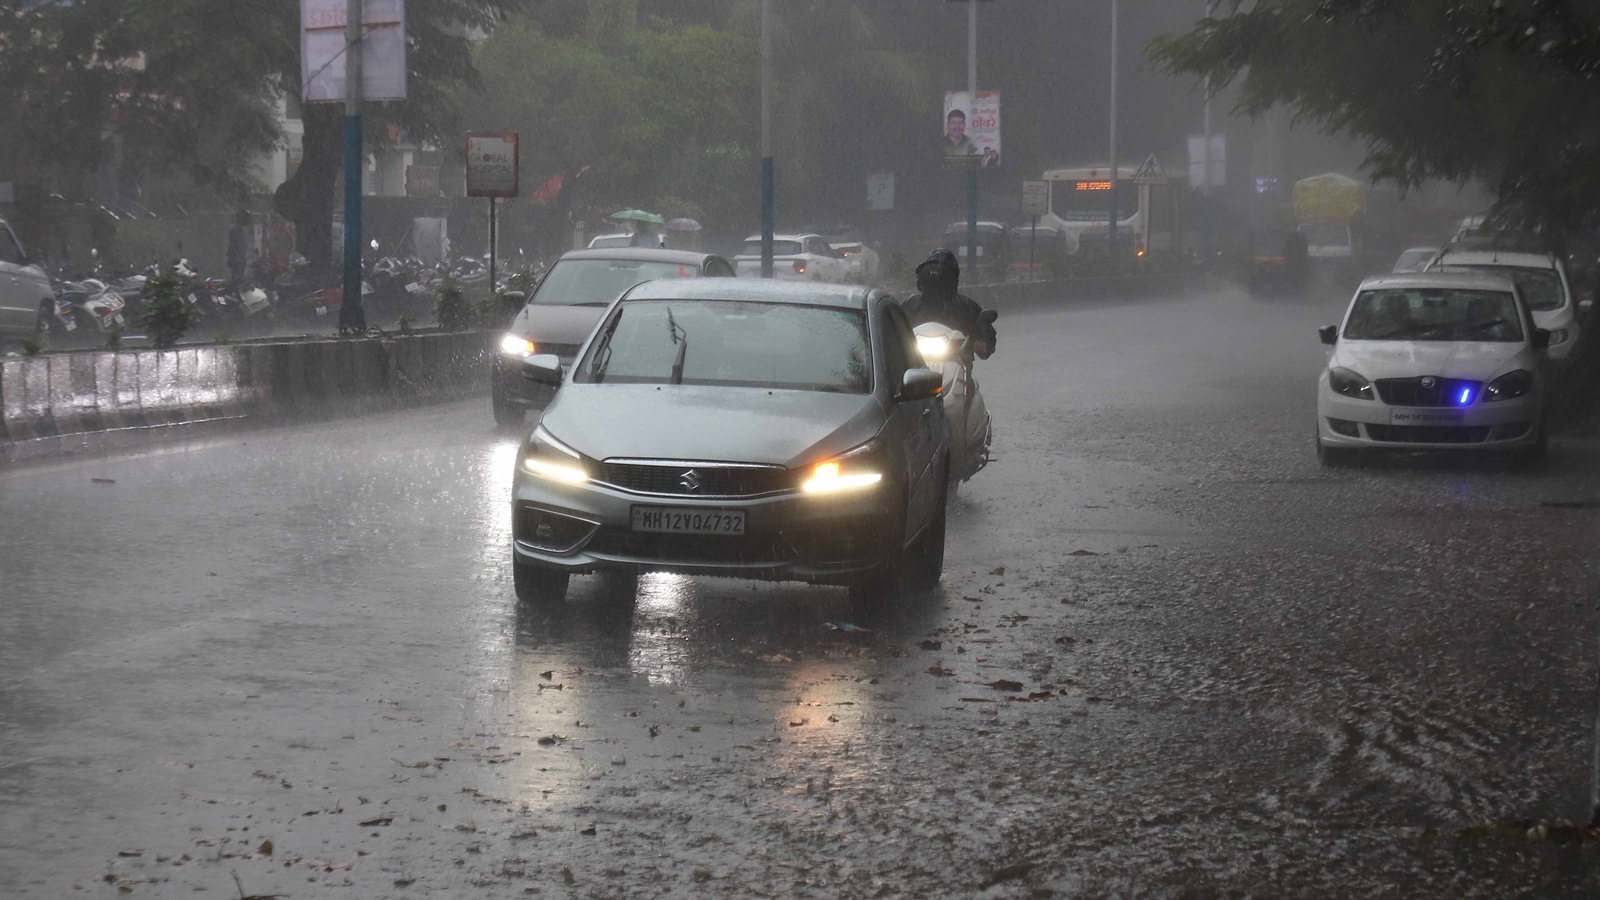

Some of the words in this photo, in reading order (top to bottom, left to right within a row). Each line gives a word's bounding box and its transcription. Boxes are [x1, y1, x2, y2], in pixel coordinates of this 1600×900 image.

[470, 154, 508, 163] GLOBAL
[470, 164, 512, 174] HOSPITAL
[642, 511, 742, 532] MH12VQ4732
